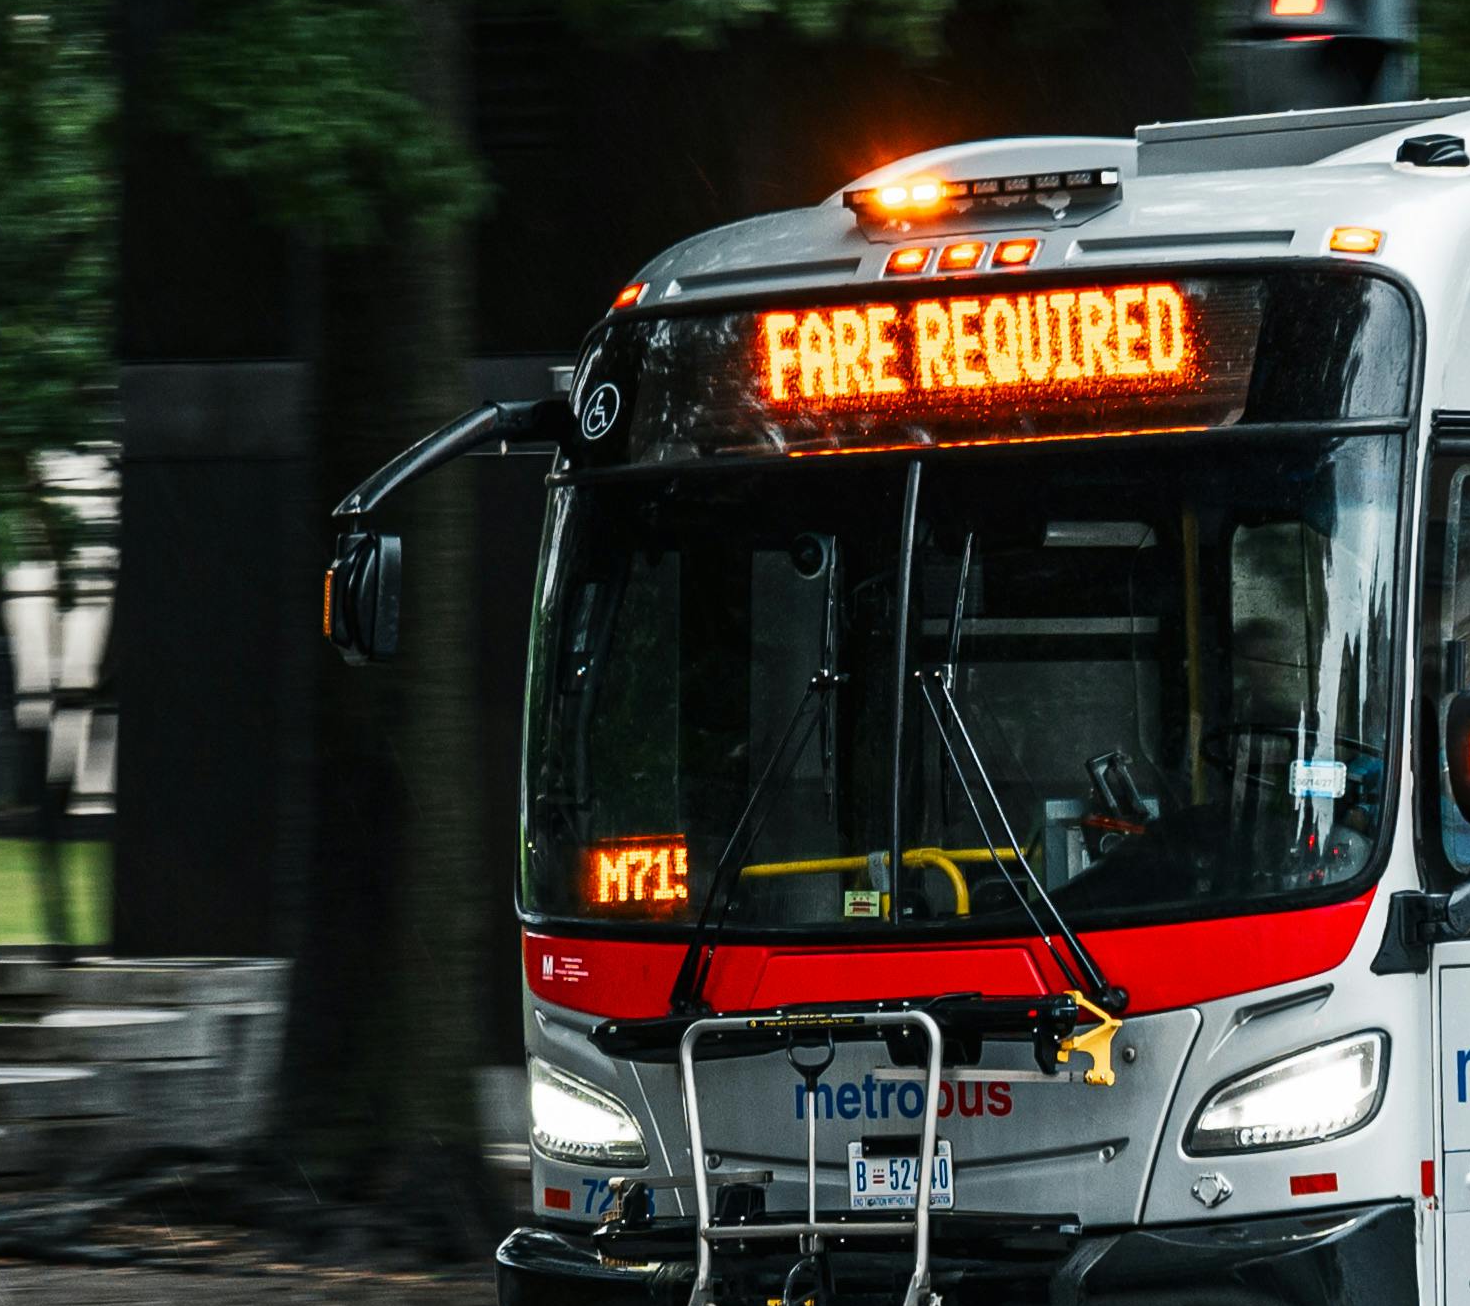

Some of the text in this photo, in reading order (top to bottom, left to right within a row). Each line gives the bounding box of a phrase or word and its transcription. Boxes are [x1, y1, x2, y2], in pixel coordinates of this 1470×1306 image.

[764, 285, 1185, 400] FARE REQUIRED
[856, 1161, 866, 1191] B
[583, 1179, 655, 1216] 72
